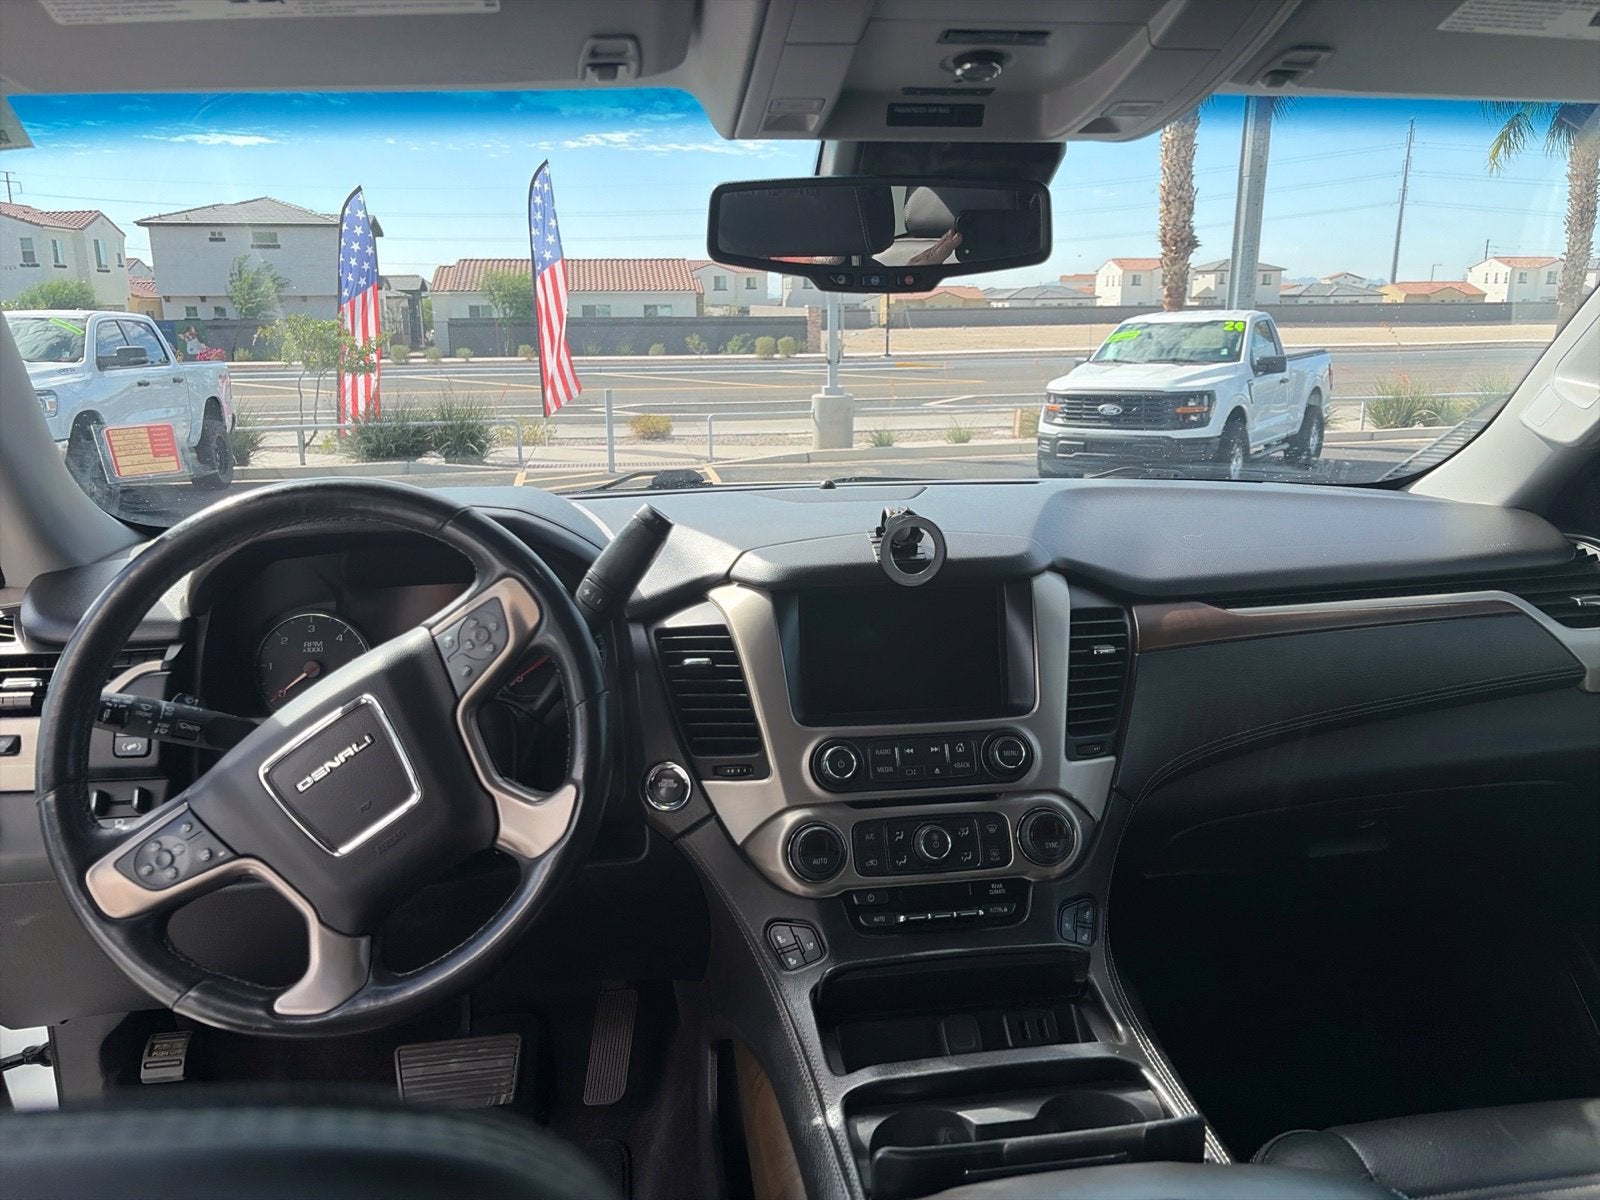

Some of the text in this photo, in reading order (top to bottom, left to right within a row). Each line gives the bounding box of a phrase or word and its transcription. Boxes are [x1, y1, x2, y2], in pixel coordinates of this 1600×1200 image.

[1223, 321, 1245, 332] 24
[308, 625, 316, 633] 3
[280, 637, 289, 645] 2
[268, 662, 273, 670] 1
[295, 733, 375, 793] DENALI
[812, 857, 828, 865] AUTO
